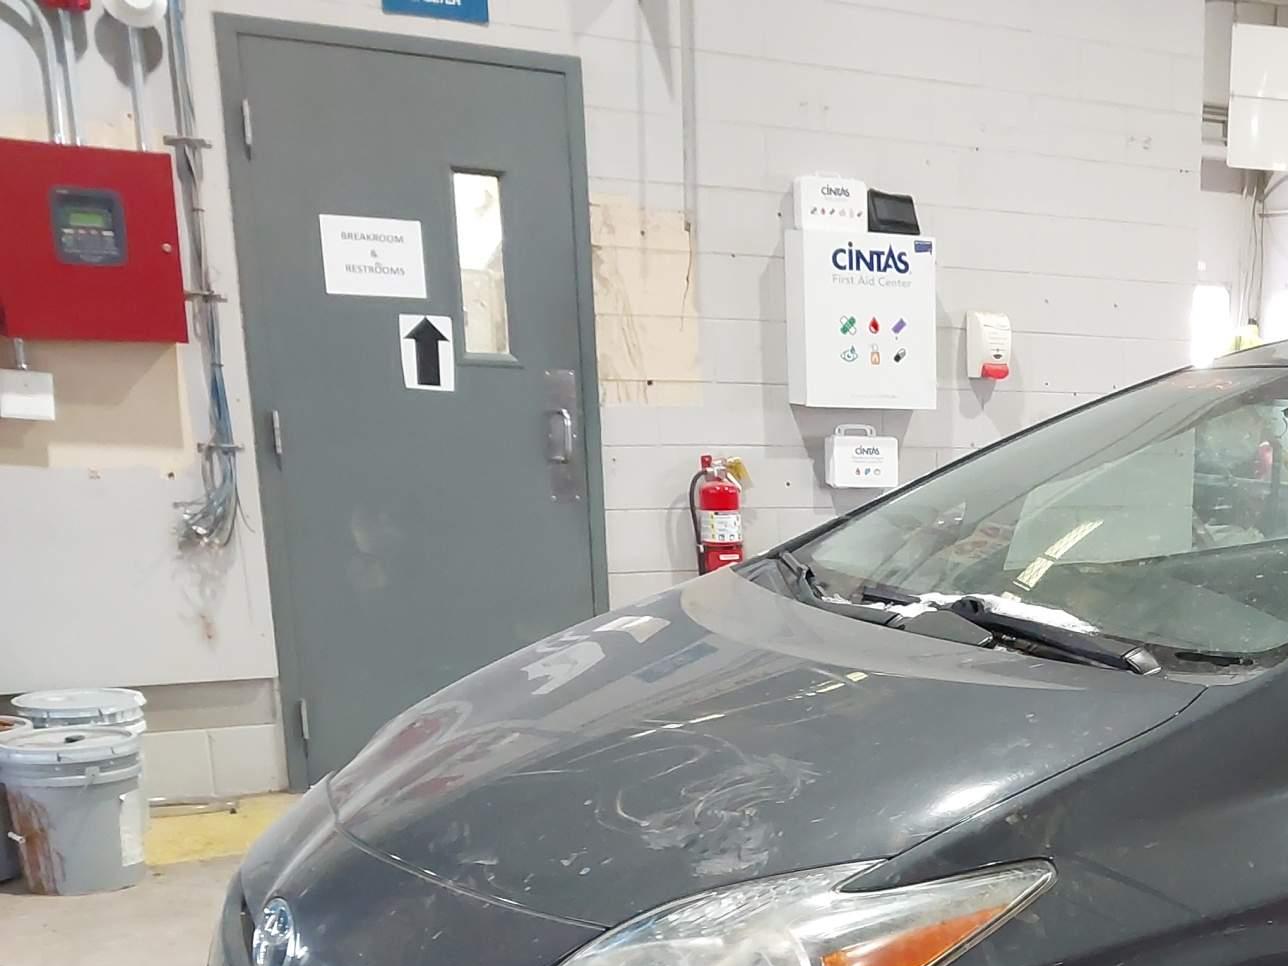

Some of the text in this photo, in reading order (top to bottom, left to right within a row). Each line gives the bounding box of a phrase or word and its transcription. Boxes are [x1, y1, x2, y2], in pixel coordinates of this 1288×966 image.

[821, 184, 850, 197] CINTAS
[340, 231, 404, 243] BREAKROOM
[370, 249, 378, 258] &
[831, 241, 910, 274] CINTAS
[345, 262, 406, 276] RESTROOMS
[832, 274, 912, 288] First Aid Center
[855, 444, 880, 455] CINTAS
